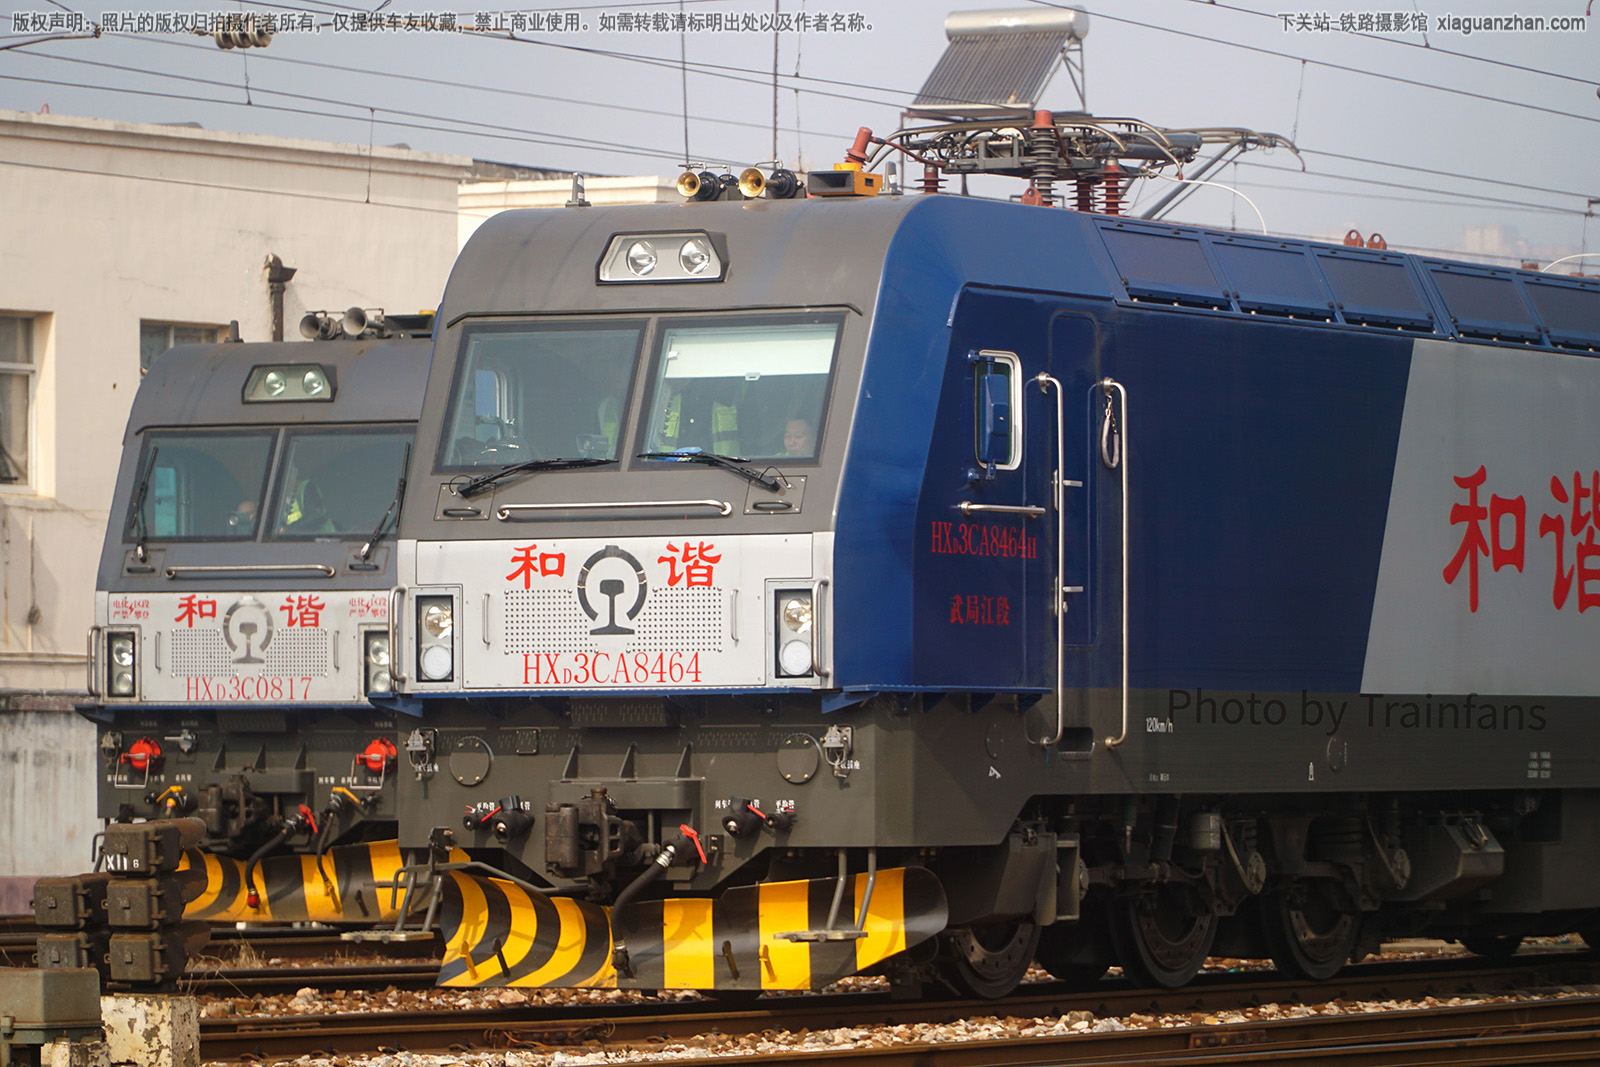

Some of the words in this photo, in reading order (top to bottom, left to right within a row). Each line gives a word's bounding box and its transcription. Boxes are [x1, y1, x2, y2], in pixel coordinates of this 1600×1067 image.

[506, 543, 566, 590] 和
[657, 541, 722, 588] 谐
[174, 594, 217, 628] 和
[279, 594, 326, 628] 谐
[522, 651, 703, 685] HXD3CA8464
[186, 676, 312, 701] HXD3C0817
[1145, 716, 1174, 733] 120km/h
[133, 858, 140, 869] 6
